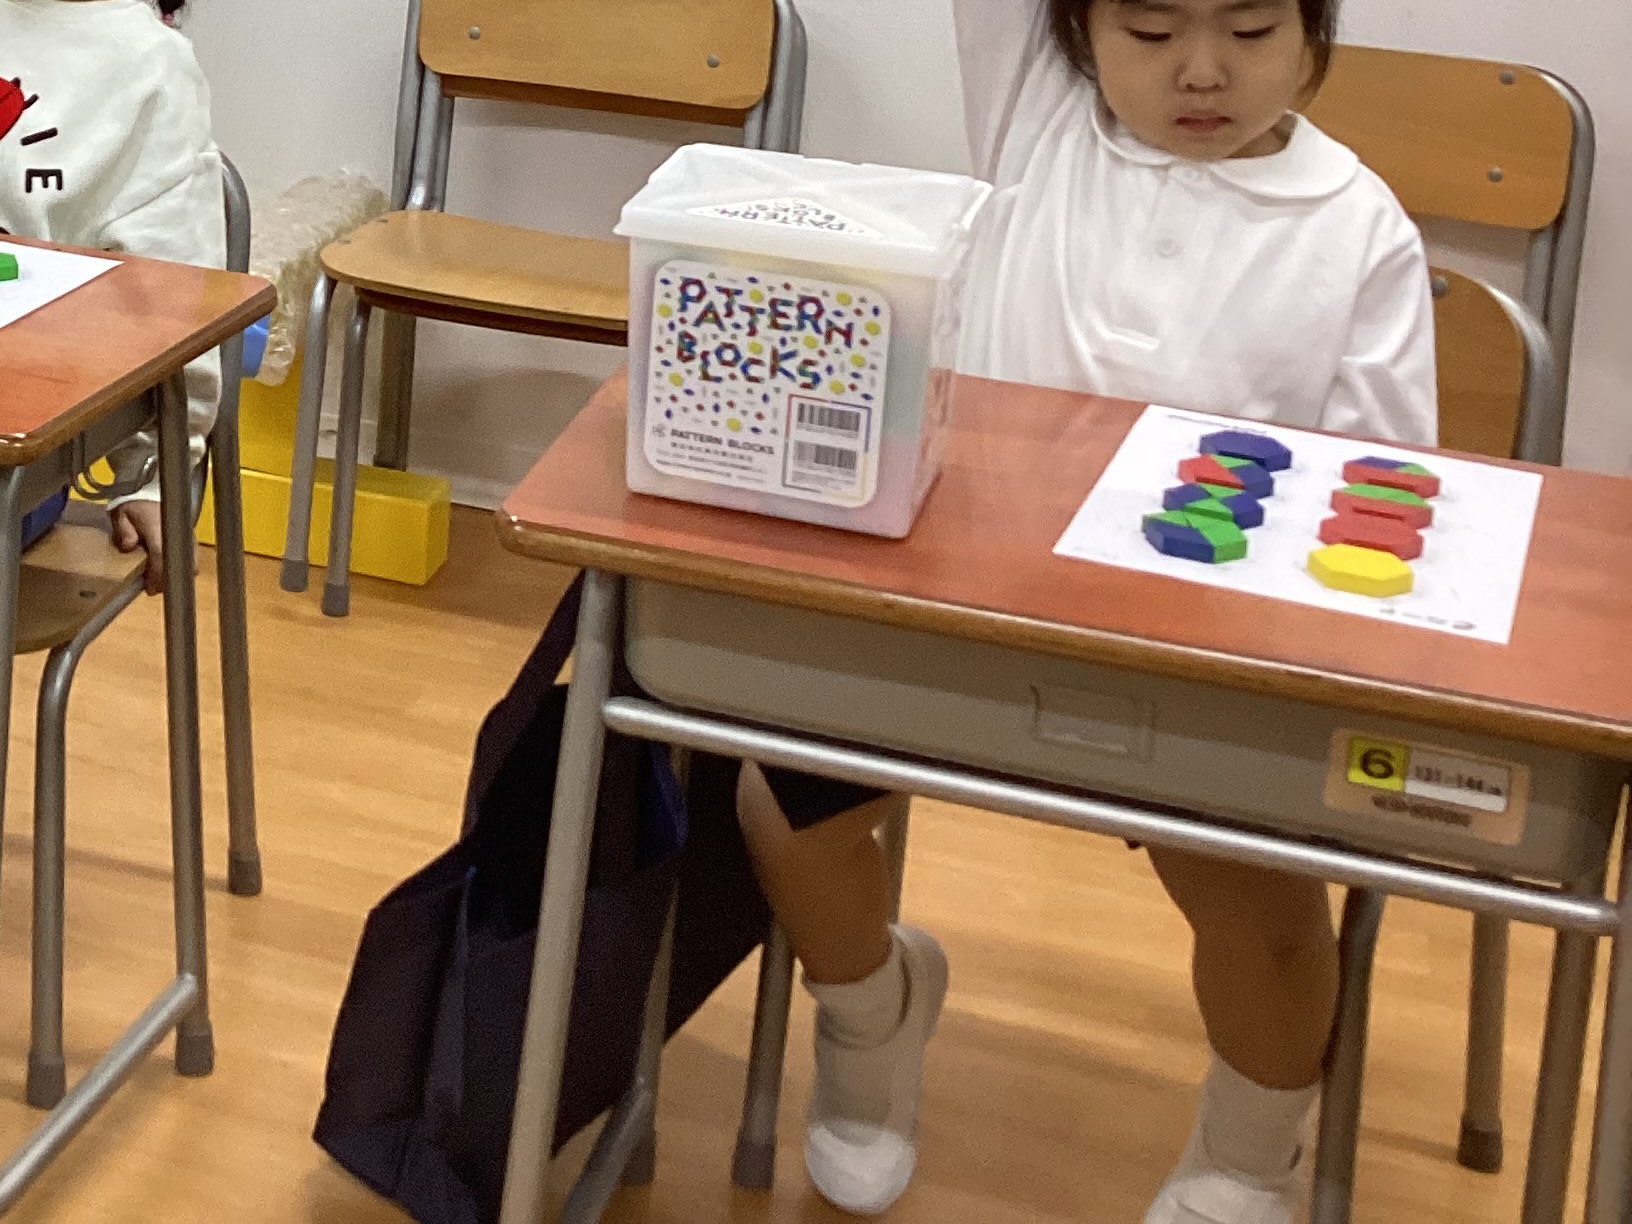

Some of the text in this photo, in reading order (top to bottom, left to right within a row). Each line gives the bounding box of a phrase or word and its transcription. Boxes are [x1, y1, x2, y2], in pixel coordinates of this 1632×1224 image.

[678, 277, 853, 348] PATTERN
[676, 330, 821, 390] BLOCKS
[1360, 749, 1394, 779] 6
